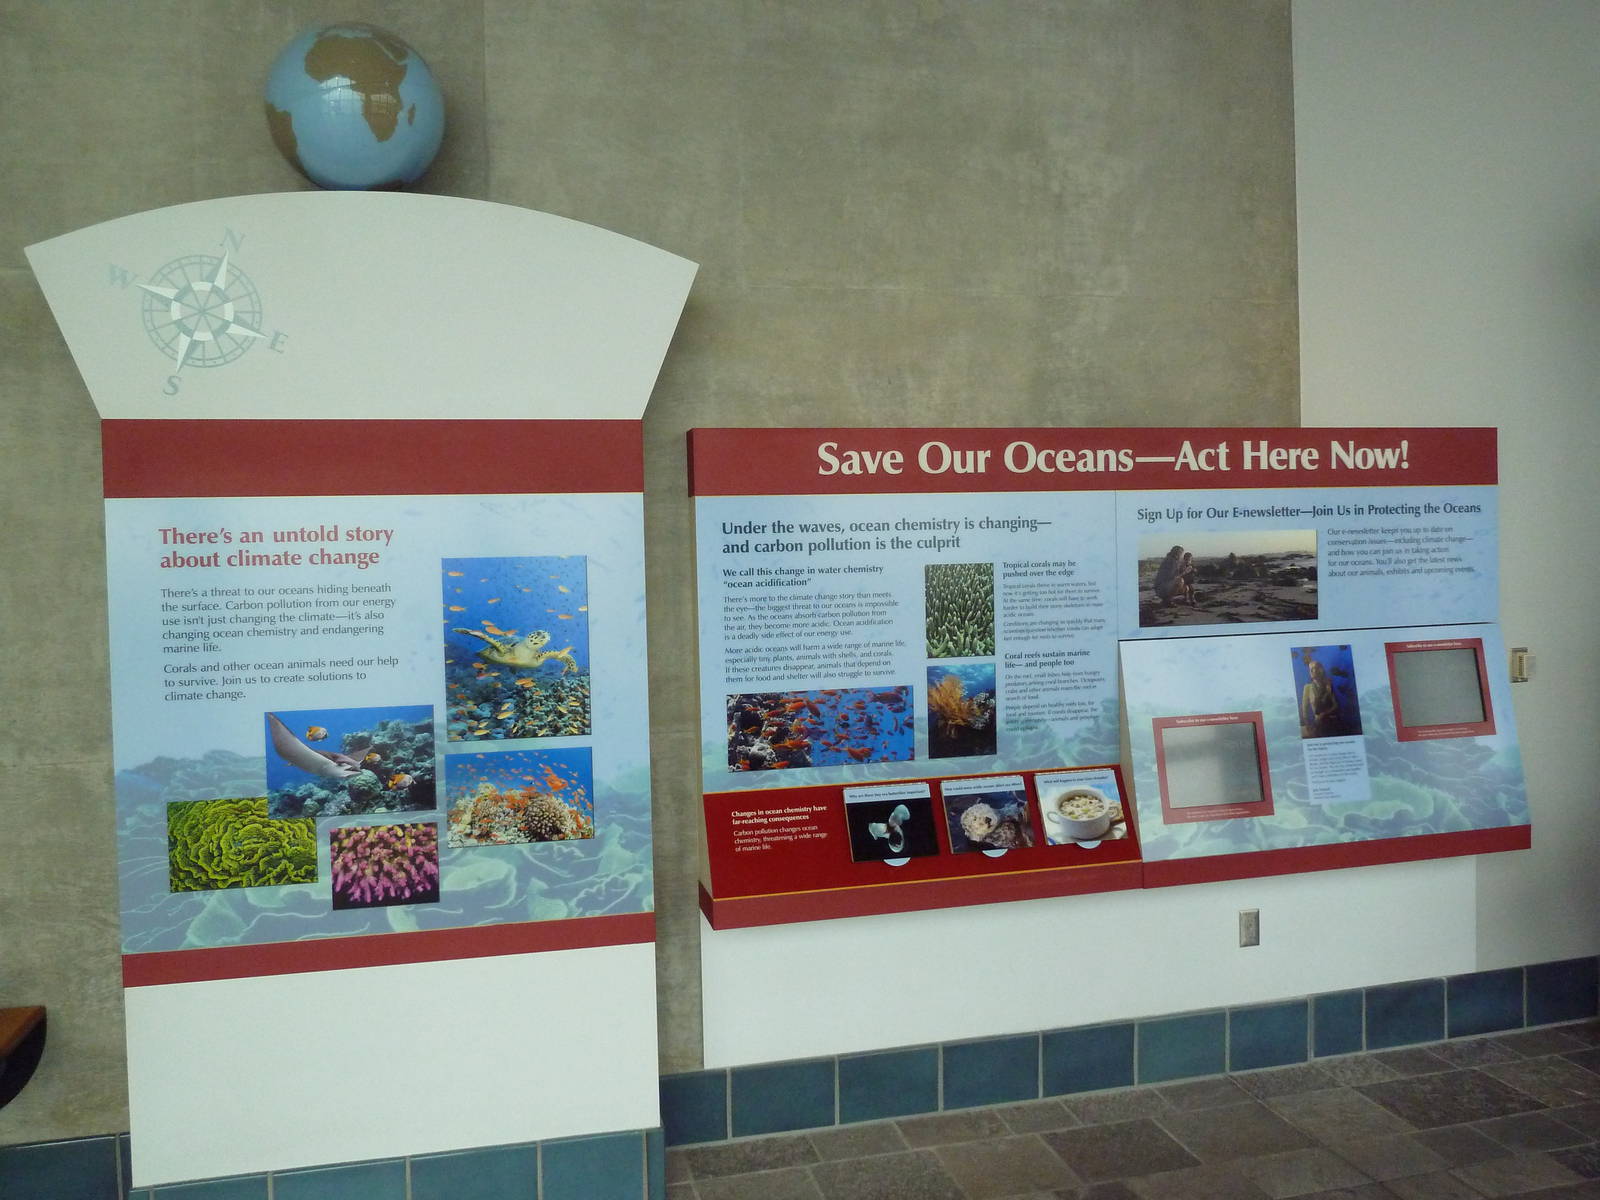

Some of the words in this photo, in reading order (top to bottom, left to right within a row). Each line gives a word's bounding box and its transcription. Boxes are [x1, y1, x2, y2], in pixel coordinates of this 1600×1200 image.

[219, 226, 246, 252] N
[107, 263, 137, 290] W
[269, 330, 289, 354] E
[162, 375, 182, 396] S
[817, 441, 904, 475] Save
[917, 441, 991, 474] Our
[1242, 440, 1320, 470] Here
[1330, 440, 1409, 469] Now!
[1137, 507, 1162, 523] Sign
[1165, 508, 1183, 522] Up
[1186, 506, 1203, 519] for
[1205, 507, 1229, 518] Our
[1336, 504, 1351, 516] Us
[1353, 503, 1364, 515] in
[1367, 503, 1421, 517] Protecting
[1423, 502, 1441, 514] the
[1442, 502, 1482, 513] Oceans
[721, 520, 768, 534] Under
[770, 519, 794, 534] the
[798, 522, 845, 533] waves,
[848, 522, 890, 532] ocean
[894, 517, 960, 533] chemistry
[964, 516, 975, 529] is
[157, 526, 233, 544] There's
[238, 530, 264, 543] an
[272, 524, 338, 542] untold
[345, 526, 394, 546] story
[721, 539, 750, 554] and
[753, 538, 803, 552] carbon
[807, 537, 871, 554] pollution
[875, 536, 886, 550] is
[889, 536, 912, 549] the
[916, 535, 960, 552] culprit
[159, 550, 221, 568] about
[226, 549, 302, 566] climate
[308, 548, 380, 569] change
[722, 568, 737, 577] We
[738, 567, 755, 576] call
[756, 566, 773, 576] this
[773, 566, 805, 577] change
[806, 565, 816, 574] in
[817, 566, 841, 574] water
[842, 564, 883, 574] chemistry
[159, 587, 199, 598] There's
[199, 589, 208, 598] a
[209, 586, 241, 597] threat
[243, 587, 255, 596] to
[277, 587, 314, 595] oceans
[316, 583, 349, 596] hiding
[350, 582, 392, 593] beneath
[160, 601, 179, 612] the
[224, 599, 264, 610] Carbon
[266, 598, 312, 611] pollution
[314, 598, 339, 607] from
[341, 599, 360, 607] our
[362, 598, 396, 608] energy
[161, 616, 181, 626] use
[182, 615, 205, 625] isn't
[206, 614, 227, 627] just
[228, 613, 277, 626] changing
[278, 612, 296, 622] the
[363, 609, 385, 620] also
[161, 628, 211, 641] changing
[211, 629, 244, 638] ocean
[245, 626, 297, 637] chemistry
[299, 624, 319, 635] and
[321, 624, 384, 636] endangering
[162, 643, 200, 653] marine
[162, 662, 200, 674] Corals
[199, 661, 220, 672] and
[222, 660, 251, 671] other
[252, 662, 284, 670] ocean
[286, 658, 326, 669] animals
[328, 656, 354, 667] need
[356, 658, 374, 666] our
[376, 655, 399, 667] help
[163, 678, 176, 688] to
[221, 675, 242, 686] Join
[244, 676, 257, 684] us
[259, 675, 271, 683] to
[272, 674, 305, 683] create
[307, 671, 354, 681] solutions
[355, 671, 367, 679] to
[164, 690, 204, 701] climate
